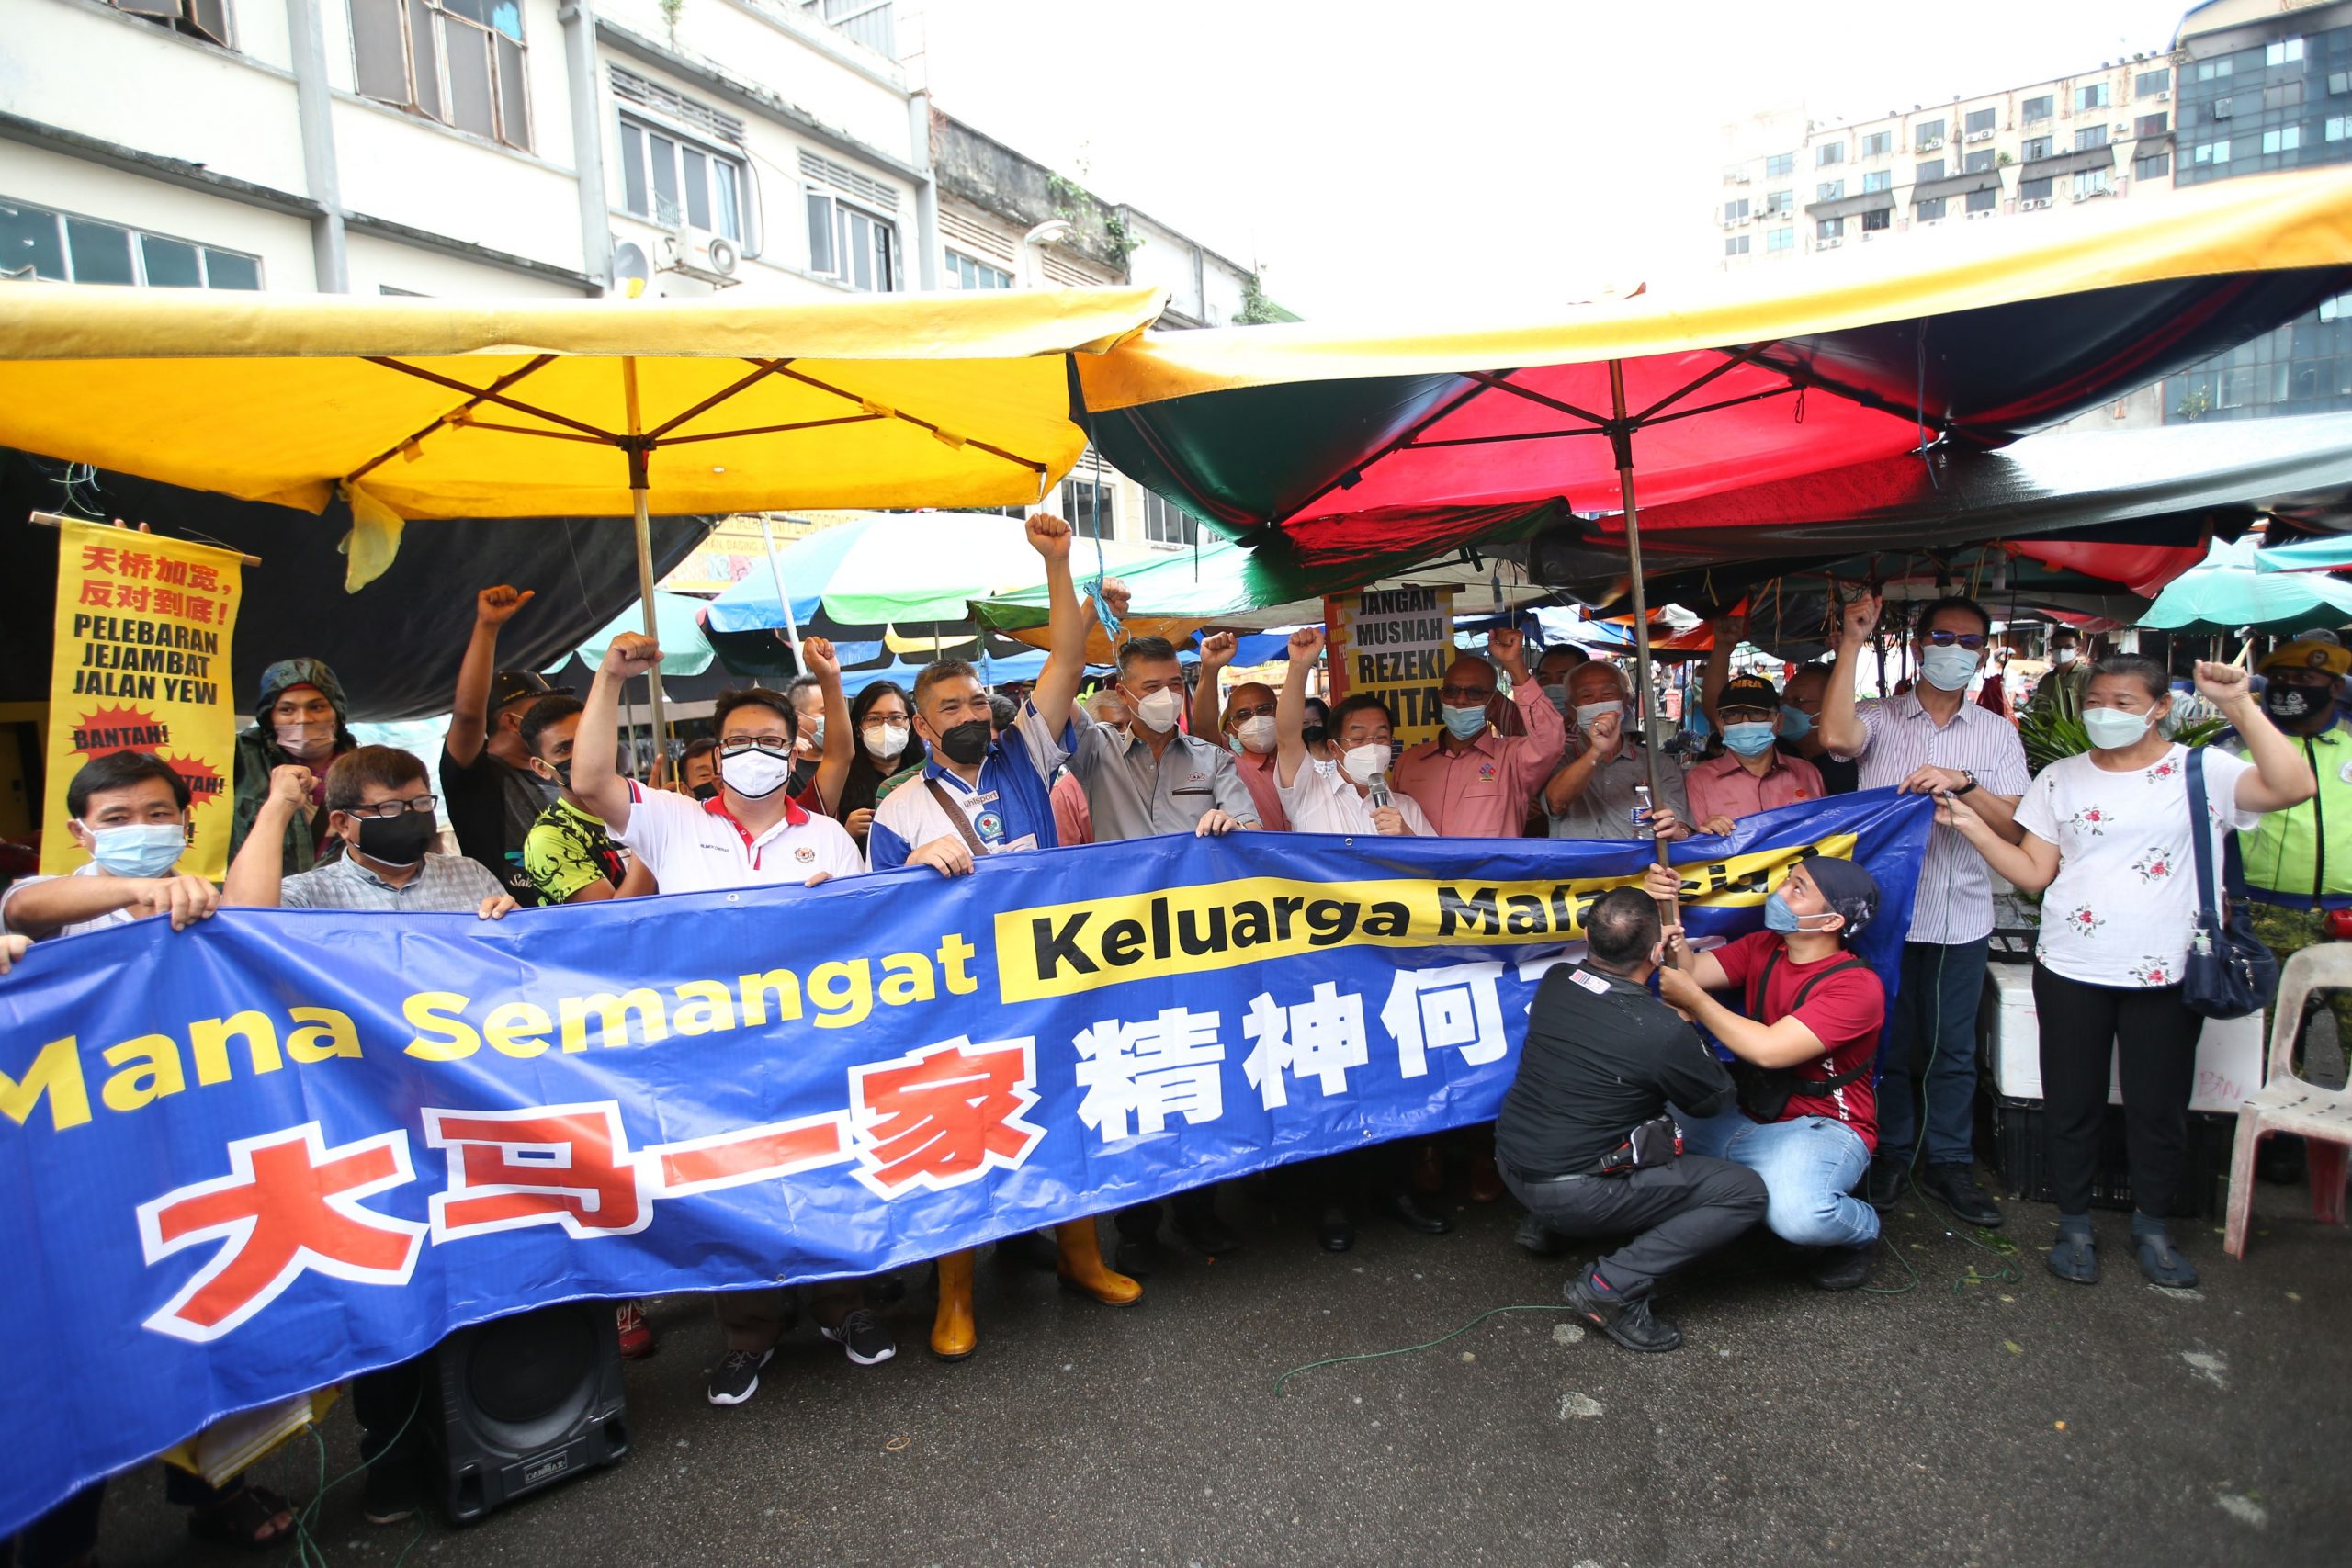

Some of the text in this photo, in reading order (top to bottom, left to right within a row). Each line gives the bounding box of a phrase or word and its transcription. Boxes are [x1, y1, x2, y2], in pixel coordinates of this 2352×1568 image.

[82, 544, 232, 595] 天桥加宽，
[79, 579, 228, 626] 反对到底！
[1360, 589, 1437, 616] JANGAN
[74, 613, 218, 655] PELEBARAN
[1356, 618, 1443, 646] MUSNAH
[82, 644, 210, 679] JEJAMBAT
[1358, 649, 1446, 683] REZEKI
[74, 670, 218, 705] JALAN YEW
[74, 724, 168, 751] BANTAH!
[0, 1006, 362, 1131] Mana
[402, 932, 978, 1061] Semangat
[1031, 896, 1408, 981] Keluarga
